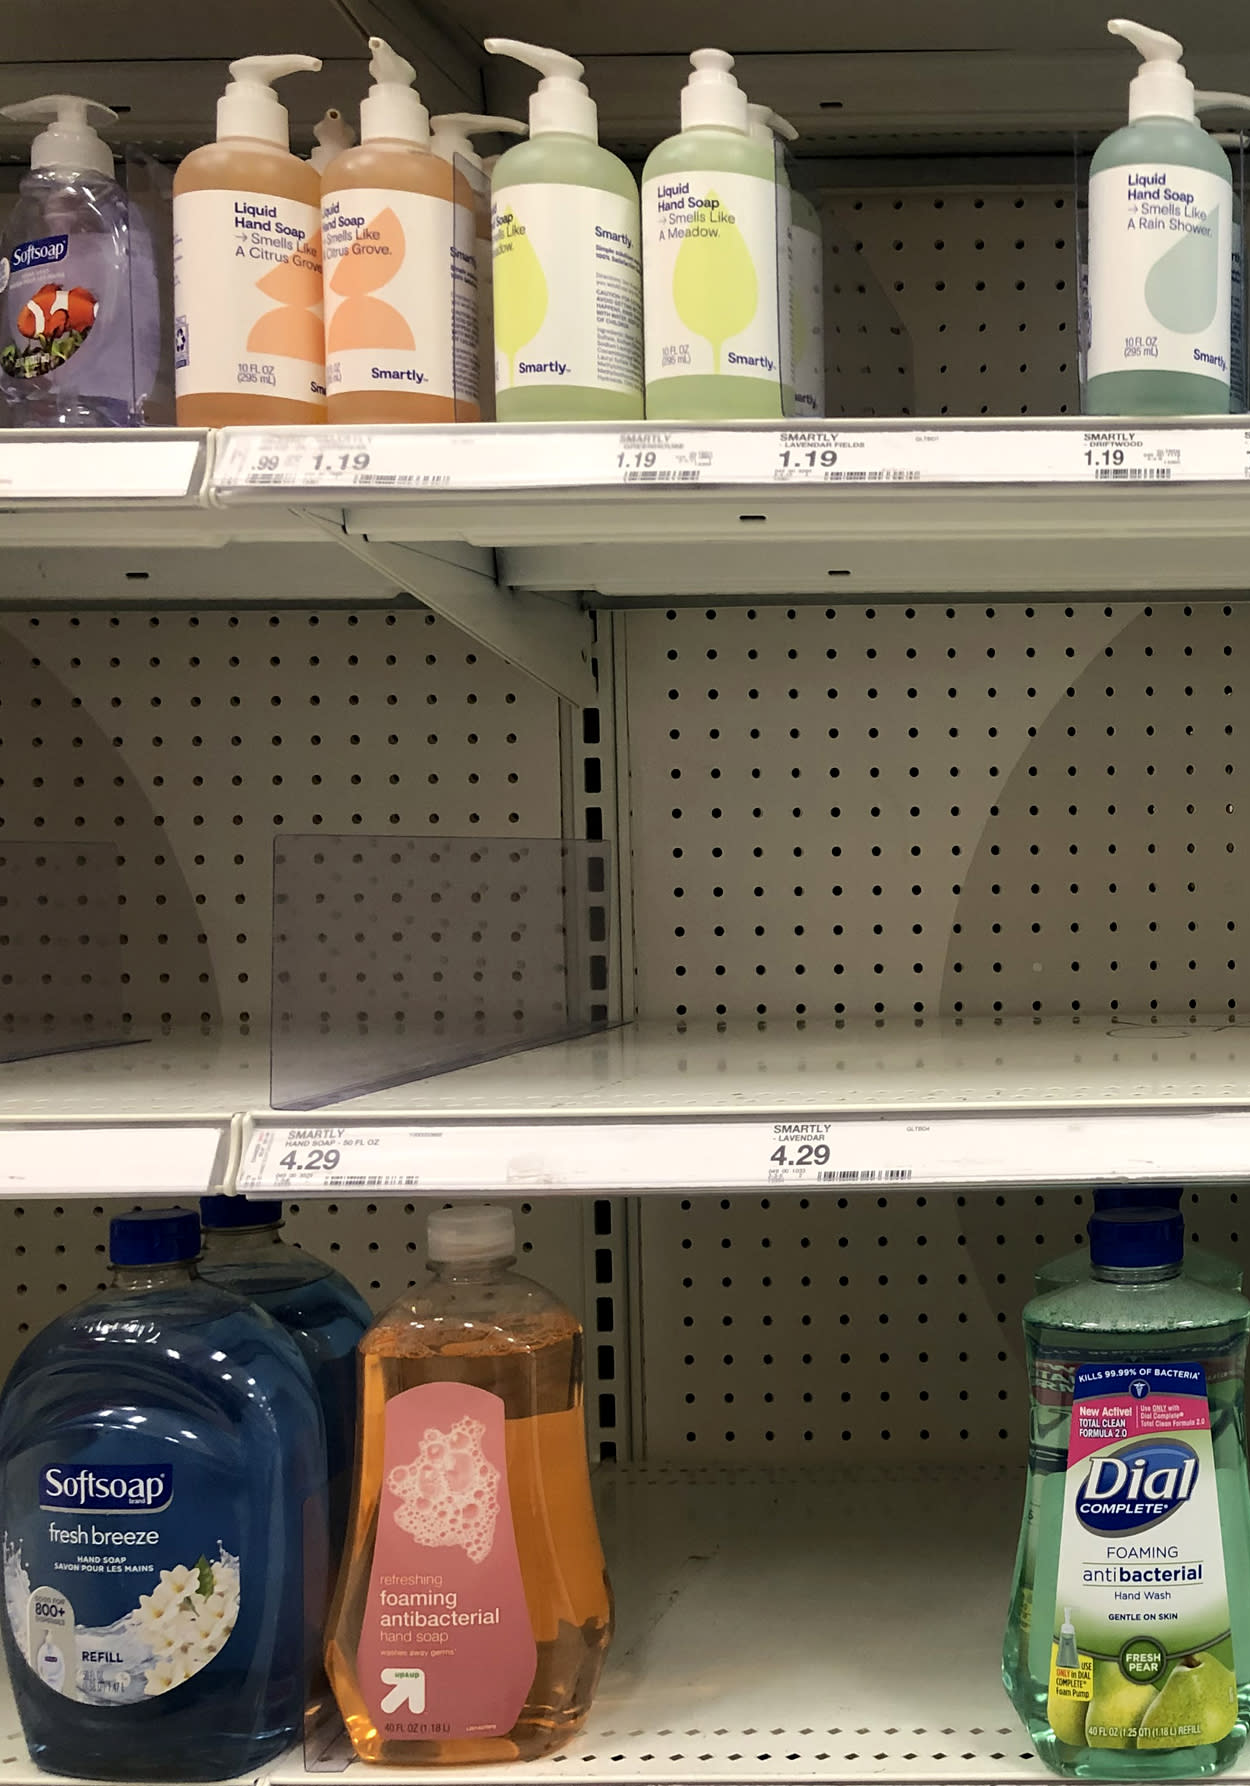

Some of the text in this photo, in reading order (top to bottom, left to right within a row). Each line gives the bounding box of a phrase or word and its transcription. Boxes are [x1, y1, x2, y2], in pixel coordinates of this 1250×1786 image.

[1128, 173, 1166, 187] Liquid
[658, 182, 689, 198] Liquid
[1128, 188, 1194, 205] Hand Soap
[234, 202, 277, 218] Liquid
[658, 197, 719, 212] Hand Soap
[1141, 202, 1206, 221] Smells Like
[669, 211, 735, 225] Smells Like
[1128, 218, 1135, 230] A
[1140, 217, 1165, 229] Rain
[235, 216, 305, 240] Hand Soap
[659, 230, 665, 241] A
[251, 233, 317, 257] Smells Like
[13, 243, 64, 265] Softsoap
[235, 247, 244, 257] A
[249, 247, 289, 264] Citrus
[779, 433, 839, 442] SMARTLY
[1084, 433, 1136, 441] SMARTLY
[313, 453, 371, 471] 1.19
[617, 451, 656, 468] 1.19
[779, 451, 838, 468] 1.19
[1084, 449, 1124, 466] 1.19
[288, 1130, 344, 1140] SMARTLY
[774, 1125, 831, 1133] SMARTLY
[280, 1149, 341, 1170] 4.29
[770, 1144, 830, 1166] 4.29
[1079, 1370, 1103, 1382] KILLS
[1105, 1369, 1136, 1378] 99.99%
[1080, 1407, 1100, 1416] New
[1079, 1419, 1125, 1428] TOTAL CLEAN
[1079, 1429, 1127, 1437] FORMULA 2.0
[1084, 1457, 1196, 1500] Dial
[46, 1468, 164, 1505] Softsoap
[49, 1522, 159, 1545] fresh breeze
[1107, 1547, 1179, 1559] FOAMING
[54, 1563, 79, 1571] SAVON
[81, 1564, 104, 1572] POUR
[1083, 1565, 1202, 1582] antibacterial
[380, 1574, 442, 1587] refreshing
[380, 1590, 457, 1608] foaming
[1115, 1592, 1171, 1600] Hand Wash
[35, 1603, 65, 1618] 800+
[380, 1608, 499, 1627] antibacterial
[380, 1631, 448, 1644] hand soap
[82, 1651, 123, 1663] REFILL
